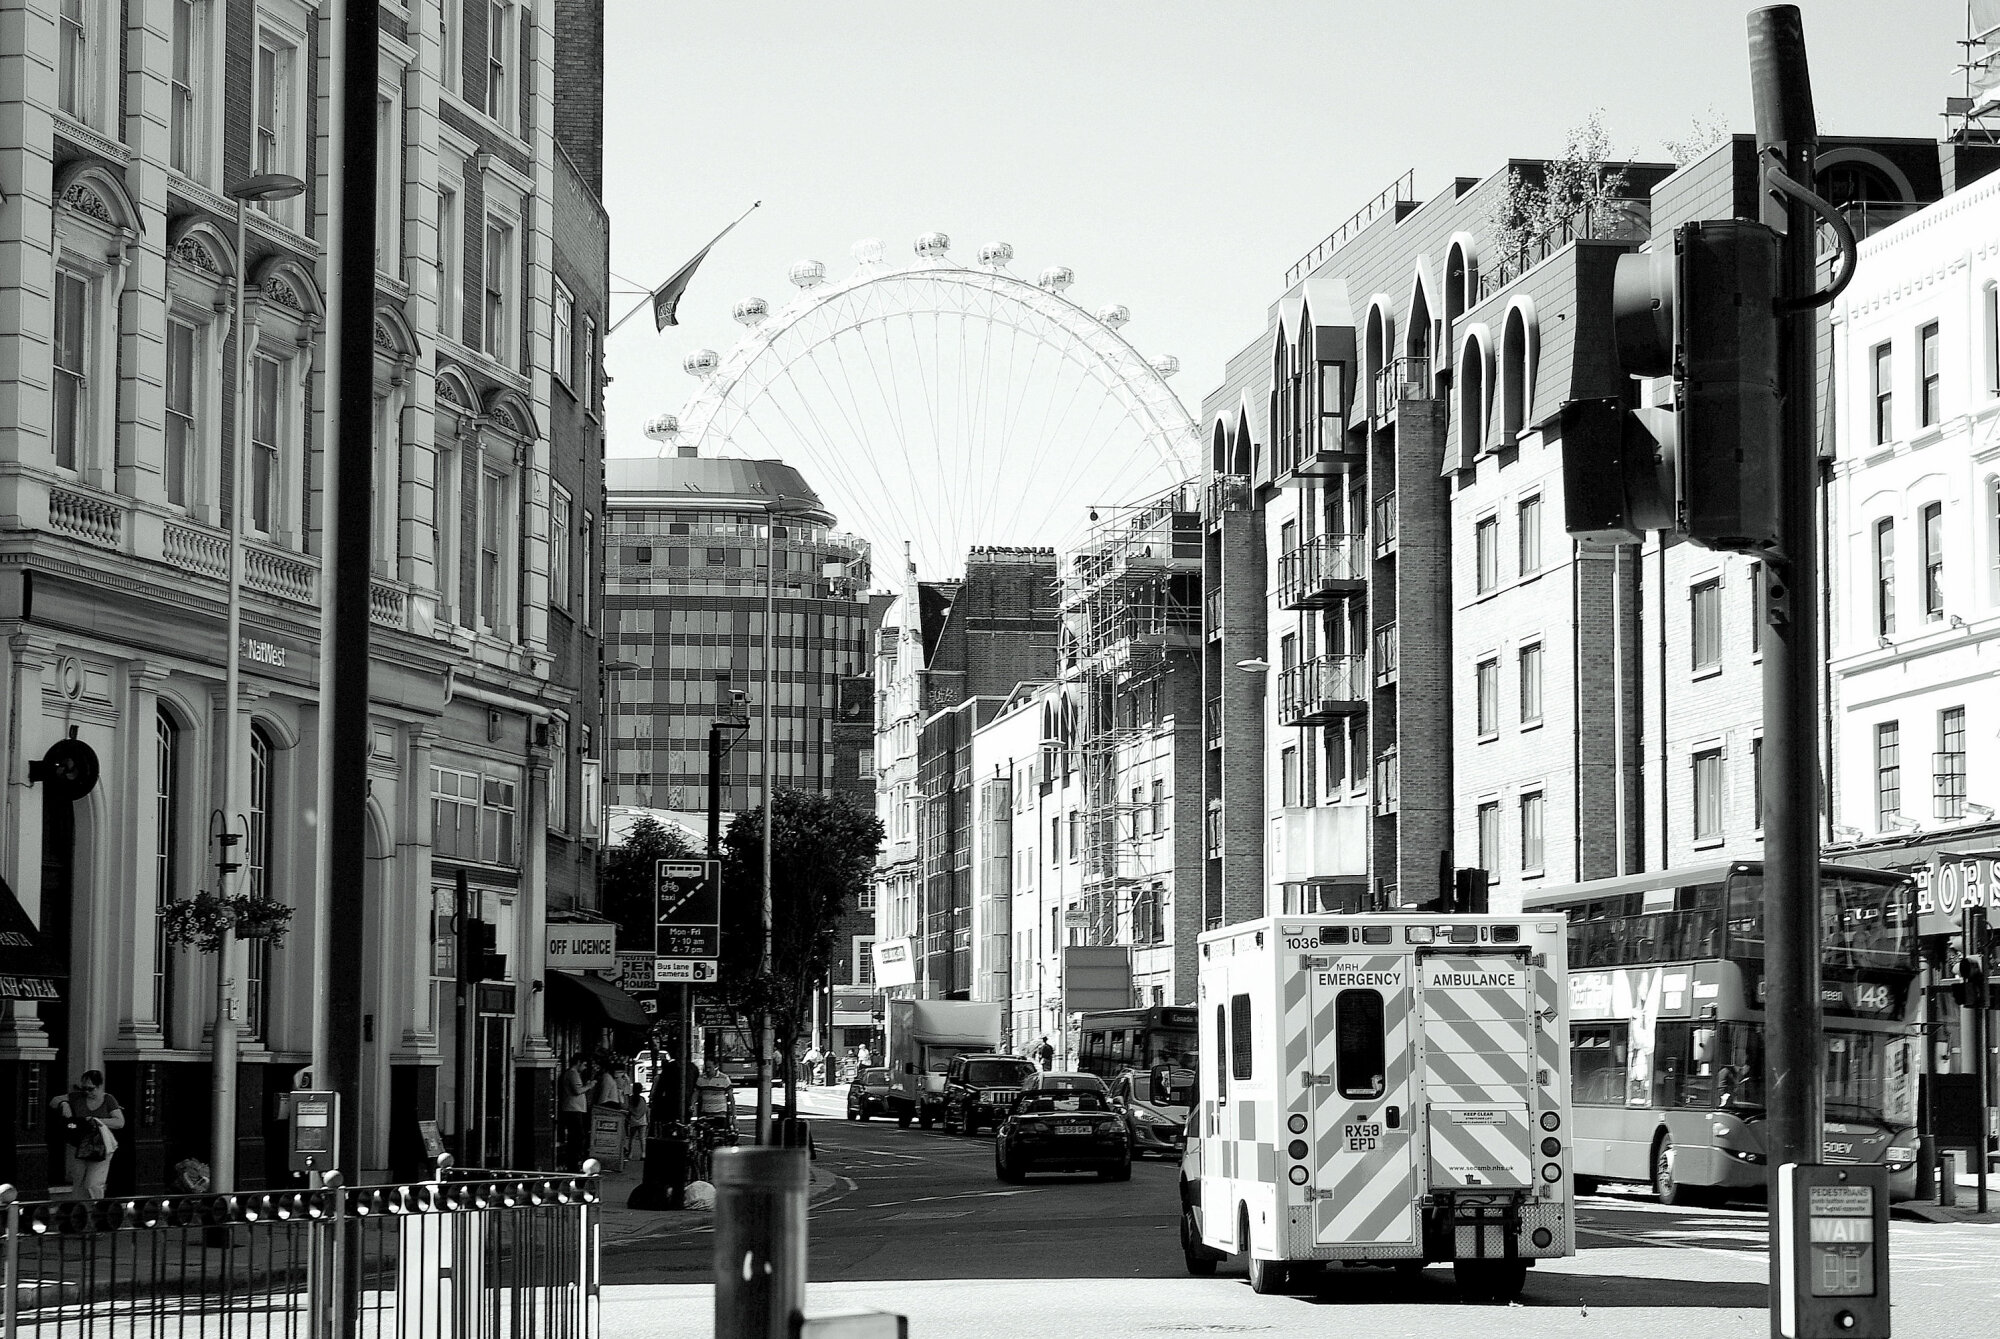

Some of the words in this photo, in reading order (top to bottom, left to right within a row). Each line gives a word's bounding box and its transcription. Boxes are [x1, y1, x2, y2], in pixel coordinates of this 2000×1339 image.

[248, 639, 286, 668] NatWest
[661, 893, 676, 901] taxi
[550, 939, 568, 955] OFF
[572, 939, 611, 955] LICENCE
[1285, 938, 1319, 949] 1036
[622, 961, 654, 971] PEN
[1336, 963, 1359, 972] MRH
[1319, 973, 1401, 986] EMERGENCY
[1433, 973, 1515, 986] AMBULANCE
[1821, 990, 1843, 1001] reen
[1856, 984, 1889, 1009] 148
[1345, 1124, 1380, 1138] RX58
[1350, 1138, 1376, 1151] EPD
[1823, 1141, 1854, 1154] SDEV
[1811, 1188, 1868, 1197] PEDESTRIANS
[1810, 1220, 1870, 1241] WAIT
